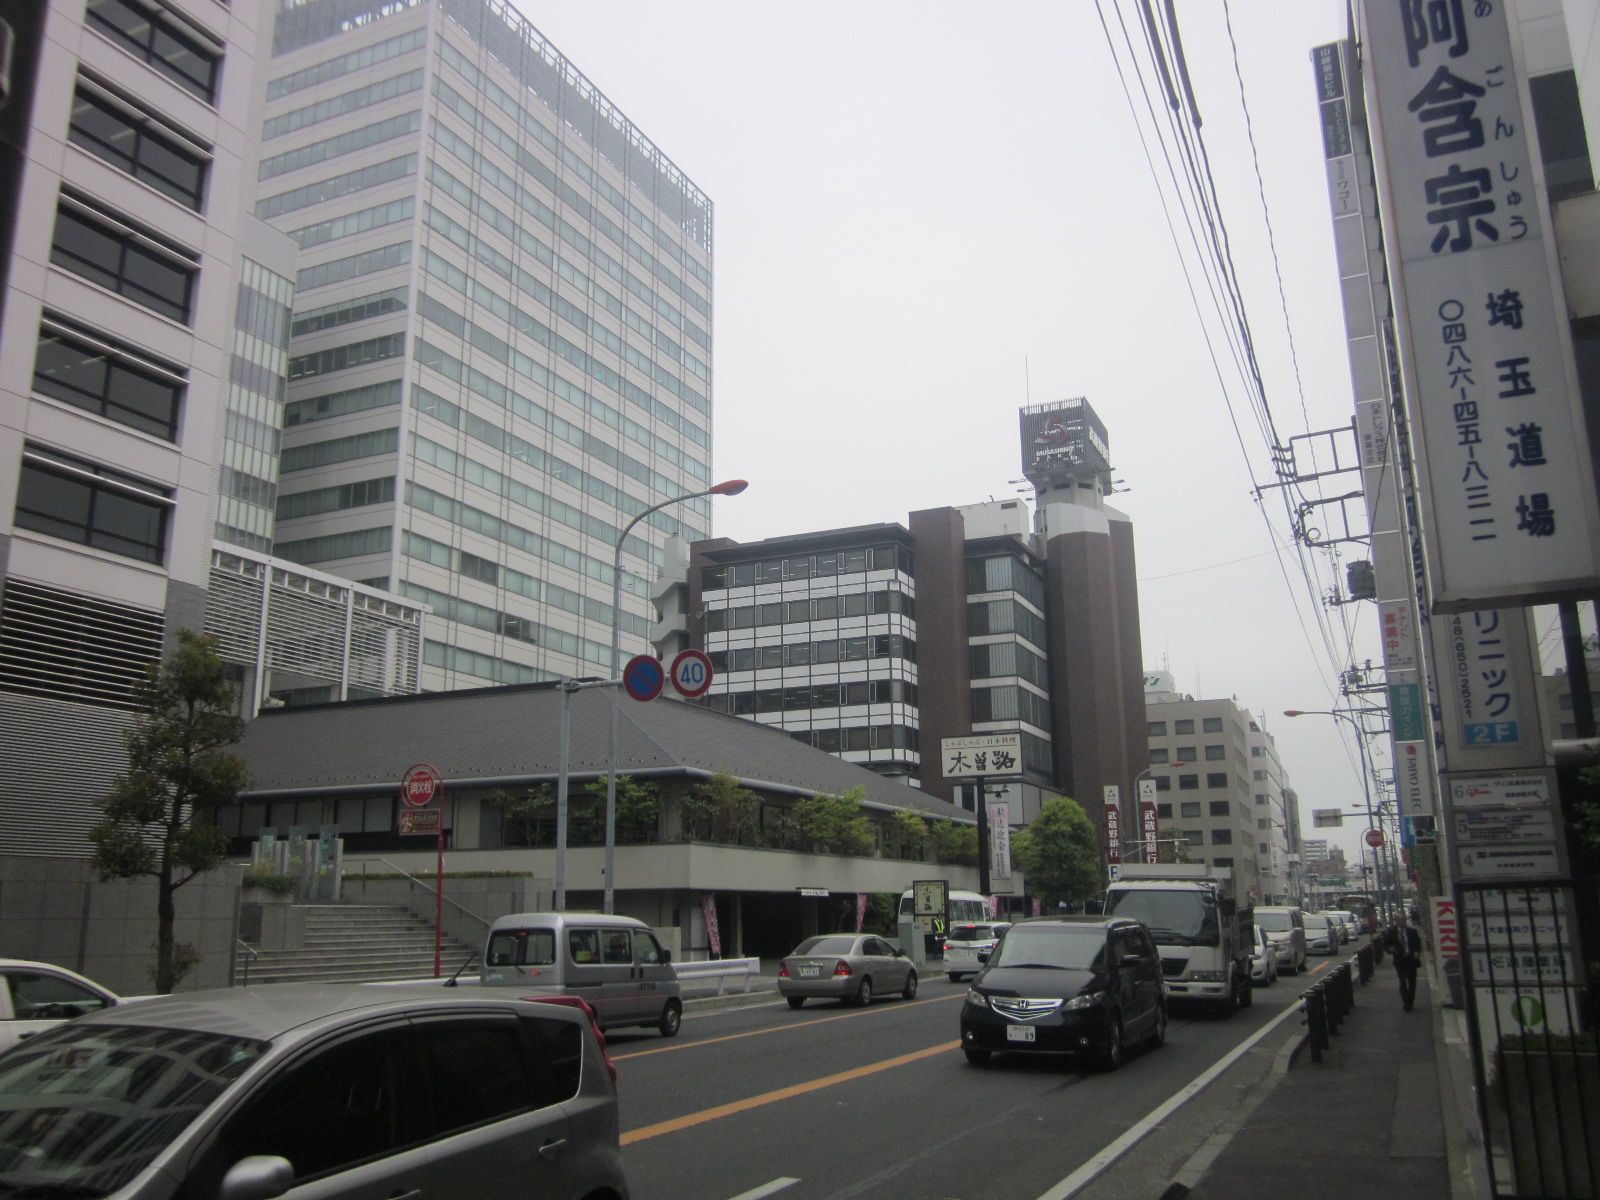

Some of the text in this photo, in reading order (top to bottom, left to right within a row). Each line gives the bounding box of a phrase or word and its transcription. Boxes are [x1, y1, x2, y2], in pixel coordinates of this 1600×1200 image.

[1401, 0, 1498, 253] 阿含宗
[1485, 288, 1556, 538] 埼玉道場
[1036, 446, 1074, 457] MUSASHINO
[680, 662, 703, 685] 40
[1473, 726, 1512, 743] 2F
[410, 780, 433, 794] 消火栓
[1453, 785, 1464, 798] 6
[1107, 811, 1120, 858] 武蔵野銀行
[1144, 810, 1157, 864] 武蔵野銀行
[1463, 853, 1473, 867] 4
[1471, 924, 1482, 937] 2
[1477, 958, 1484, 972] 1
[1025, 1032, 1034, 1040] 89
